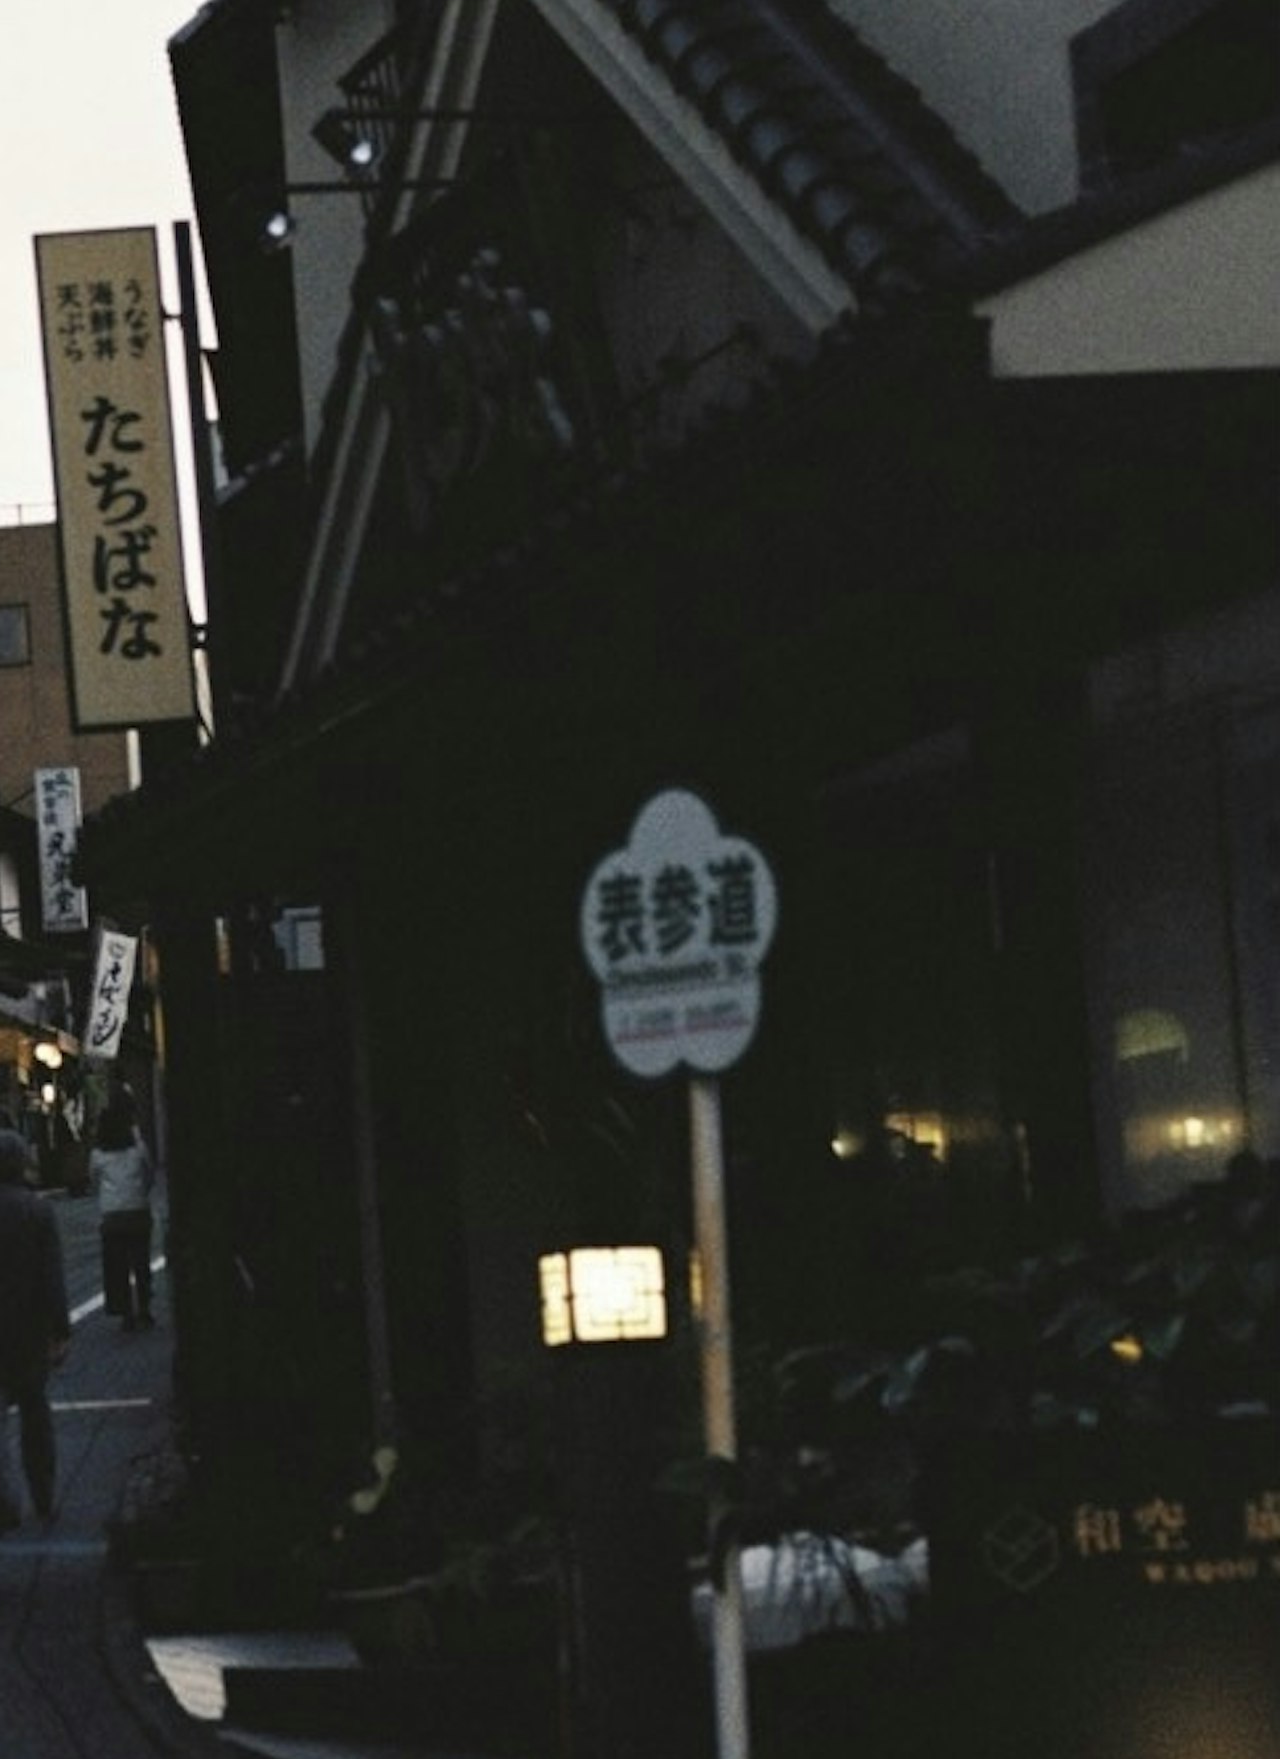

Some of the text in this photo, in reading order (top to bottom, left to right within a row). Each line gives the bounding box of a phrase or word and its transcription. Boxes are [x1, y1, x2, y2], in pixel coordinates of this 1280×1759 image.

[56, 283, 86, 363] 天ぷら
[124, 279, 151, 360] うなぎ
[79, 395, 164, 661] たちばな
[599, 856, 757, 960] 表参道
